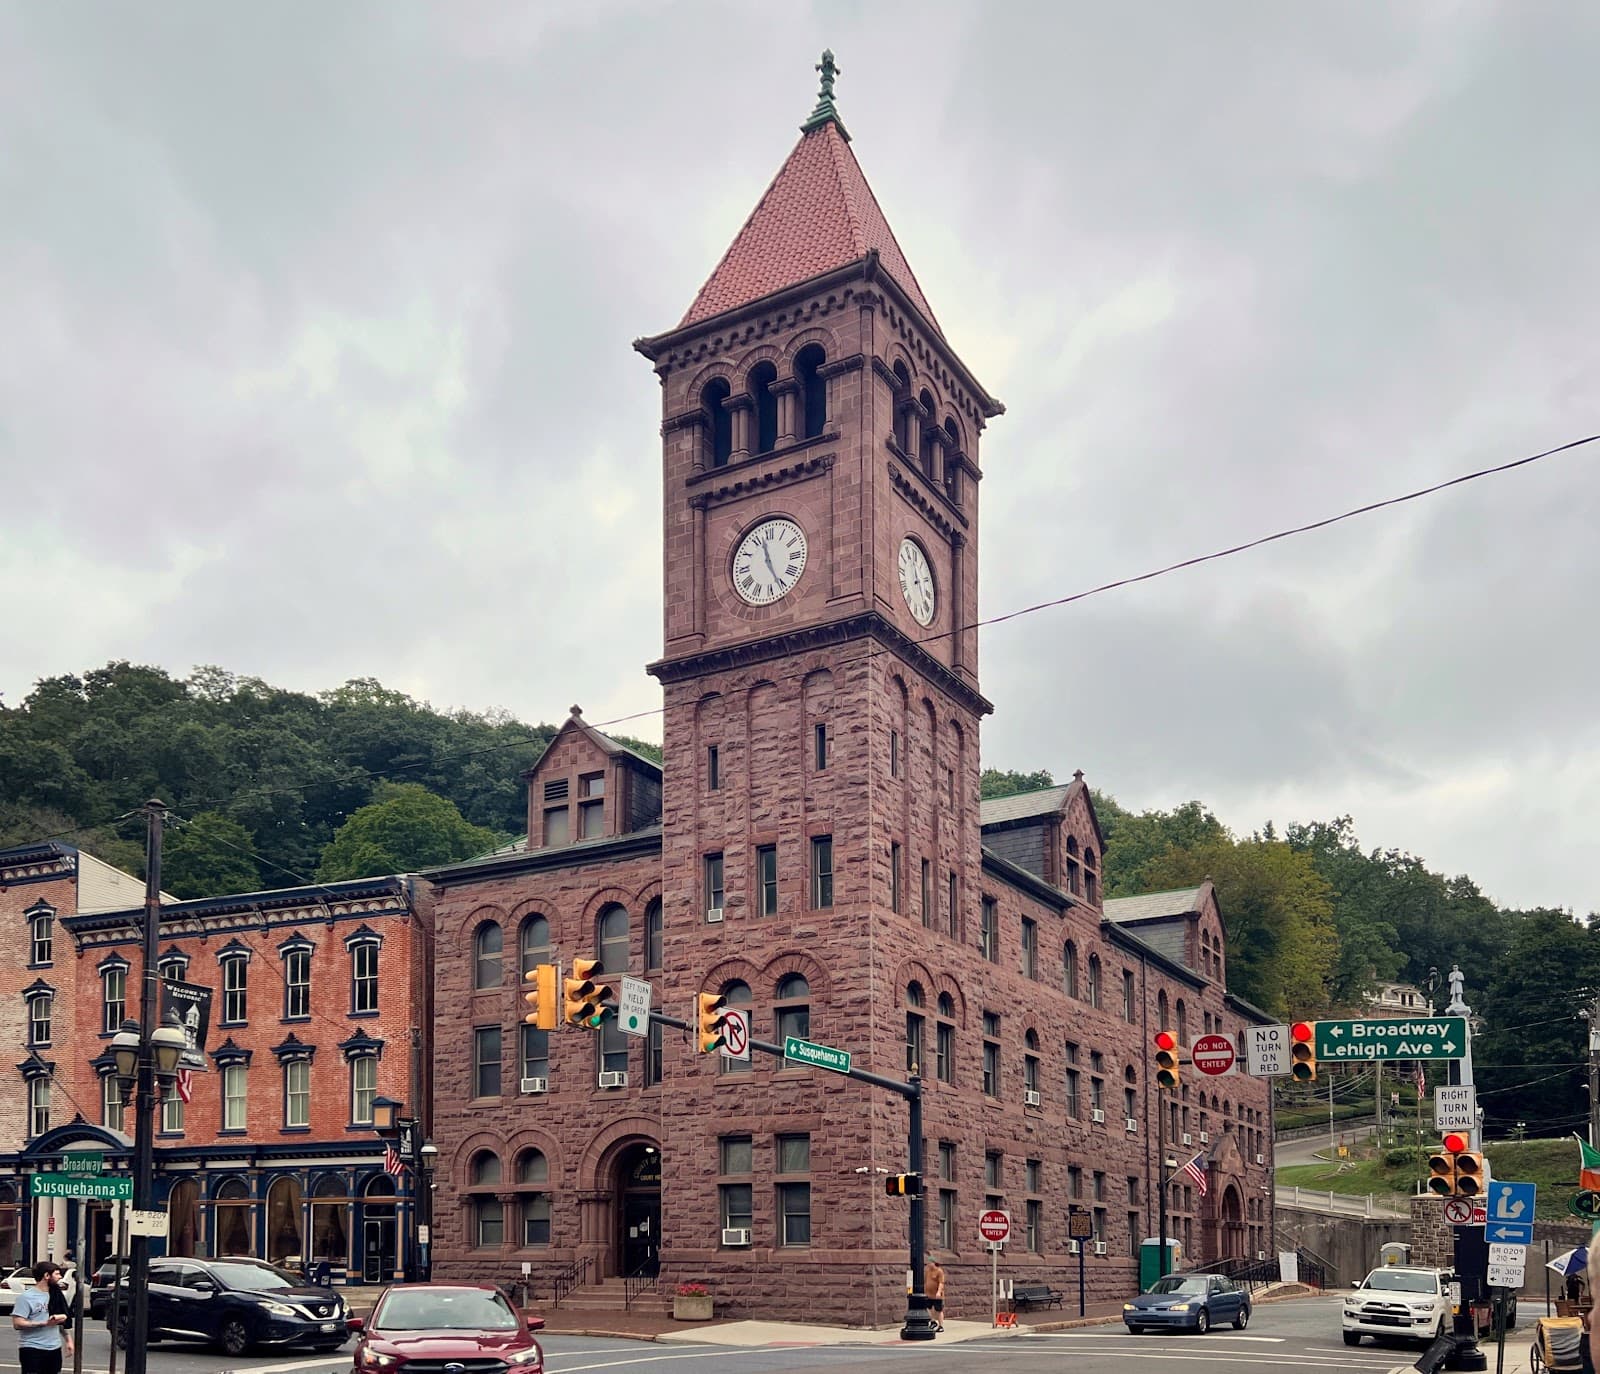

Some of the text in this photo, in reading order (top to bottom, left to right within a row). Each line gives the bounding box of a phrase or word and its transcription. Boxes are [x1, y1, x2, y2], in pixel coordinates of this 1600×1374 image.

[166, 984, 198, 996] WELCOME
[624, 982, 649, 994] LEFT TURN
[172, 991, 202, 1002] HISTORIC
[628, 993, 644, 1004] YIELD
[623, 1002, 647, 1015] ON GREEN
[1351, 1022, 1450, 1038] Broadway
[1256, 1030, 1279, 1042] NO
[1256, 1043, 1281, 1052] TURN
[1323, 1041, 1433, 1060] Lehigh Ave
[798, 1043, 846, 1066] Susquehanna St
[1262, 1053, 1276, 1062] ON
[1260, 1063, 1279, 1072] RED
[1441, 1090, 1468, 1100] RIGHT
[1443, 1103, 1468, 1112] TURN
[1438, 1116, 1472, 1125] SIGNAL
[63, 1155, 102, 1173] Broadway
[34, 1177, 130, 1196] Susquehanna ST
[148, 1211, 167, 1219] 0209
[1503, 1247, 1524, 1255] 0209
[1504, 1268, 1522, 1276] 3012
